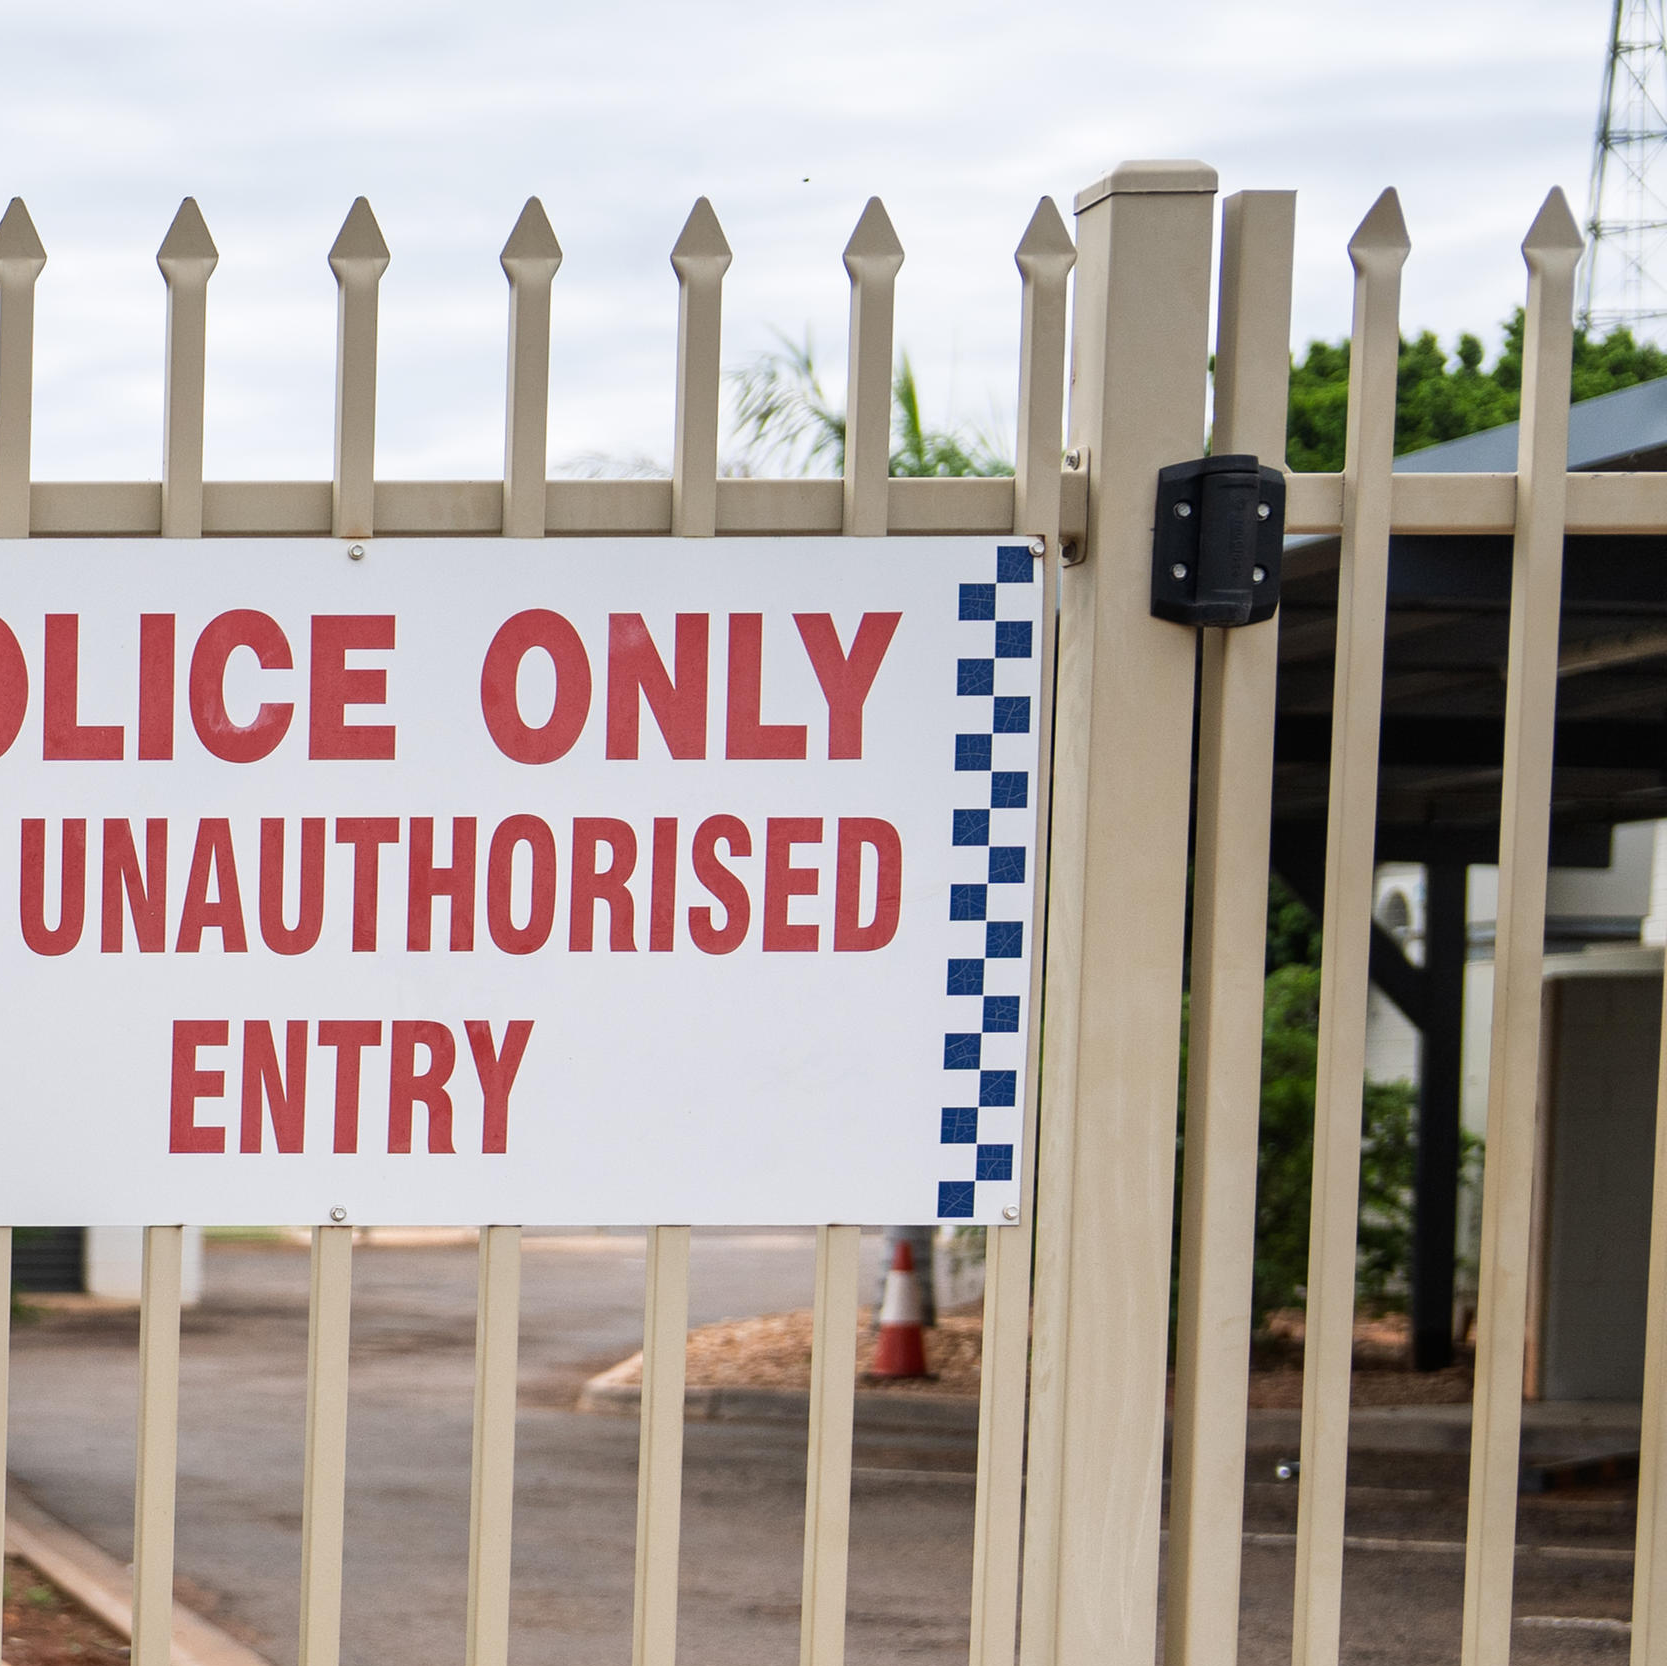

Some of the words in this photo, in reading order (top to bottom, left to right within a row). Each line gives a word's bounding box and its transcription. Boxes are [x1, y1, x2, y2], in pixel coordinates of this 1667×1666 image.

[481, 608, 902, 765] ONLY
[20, 813, 902, 956] UNAUTHORISED
[169, 1019, 534, 1154] ENTRY
